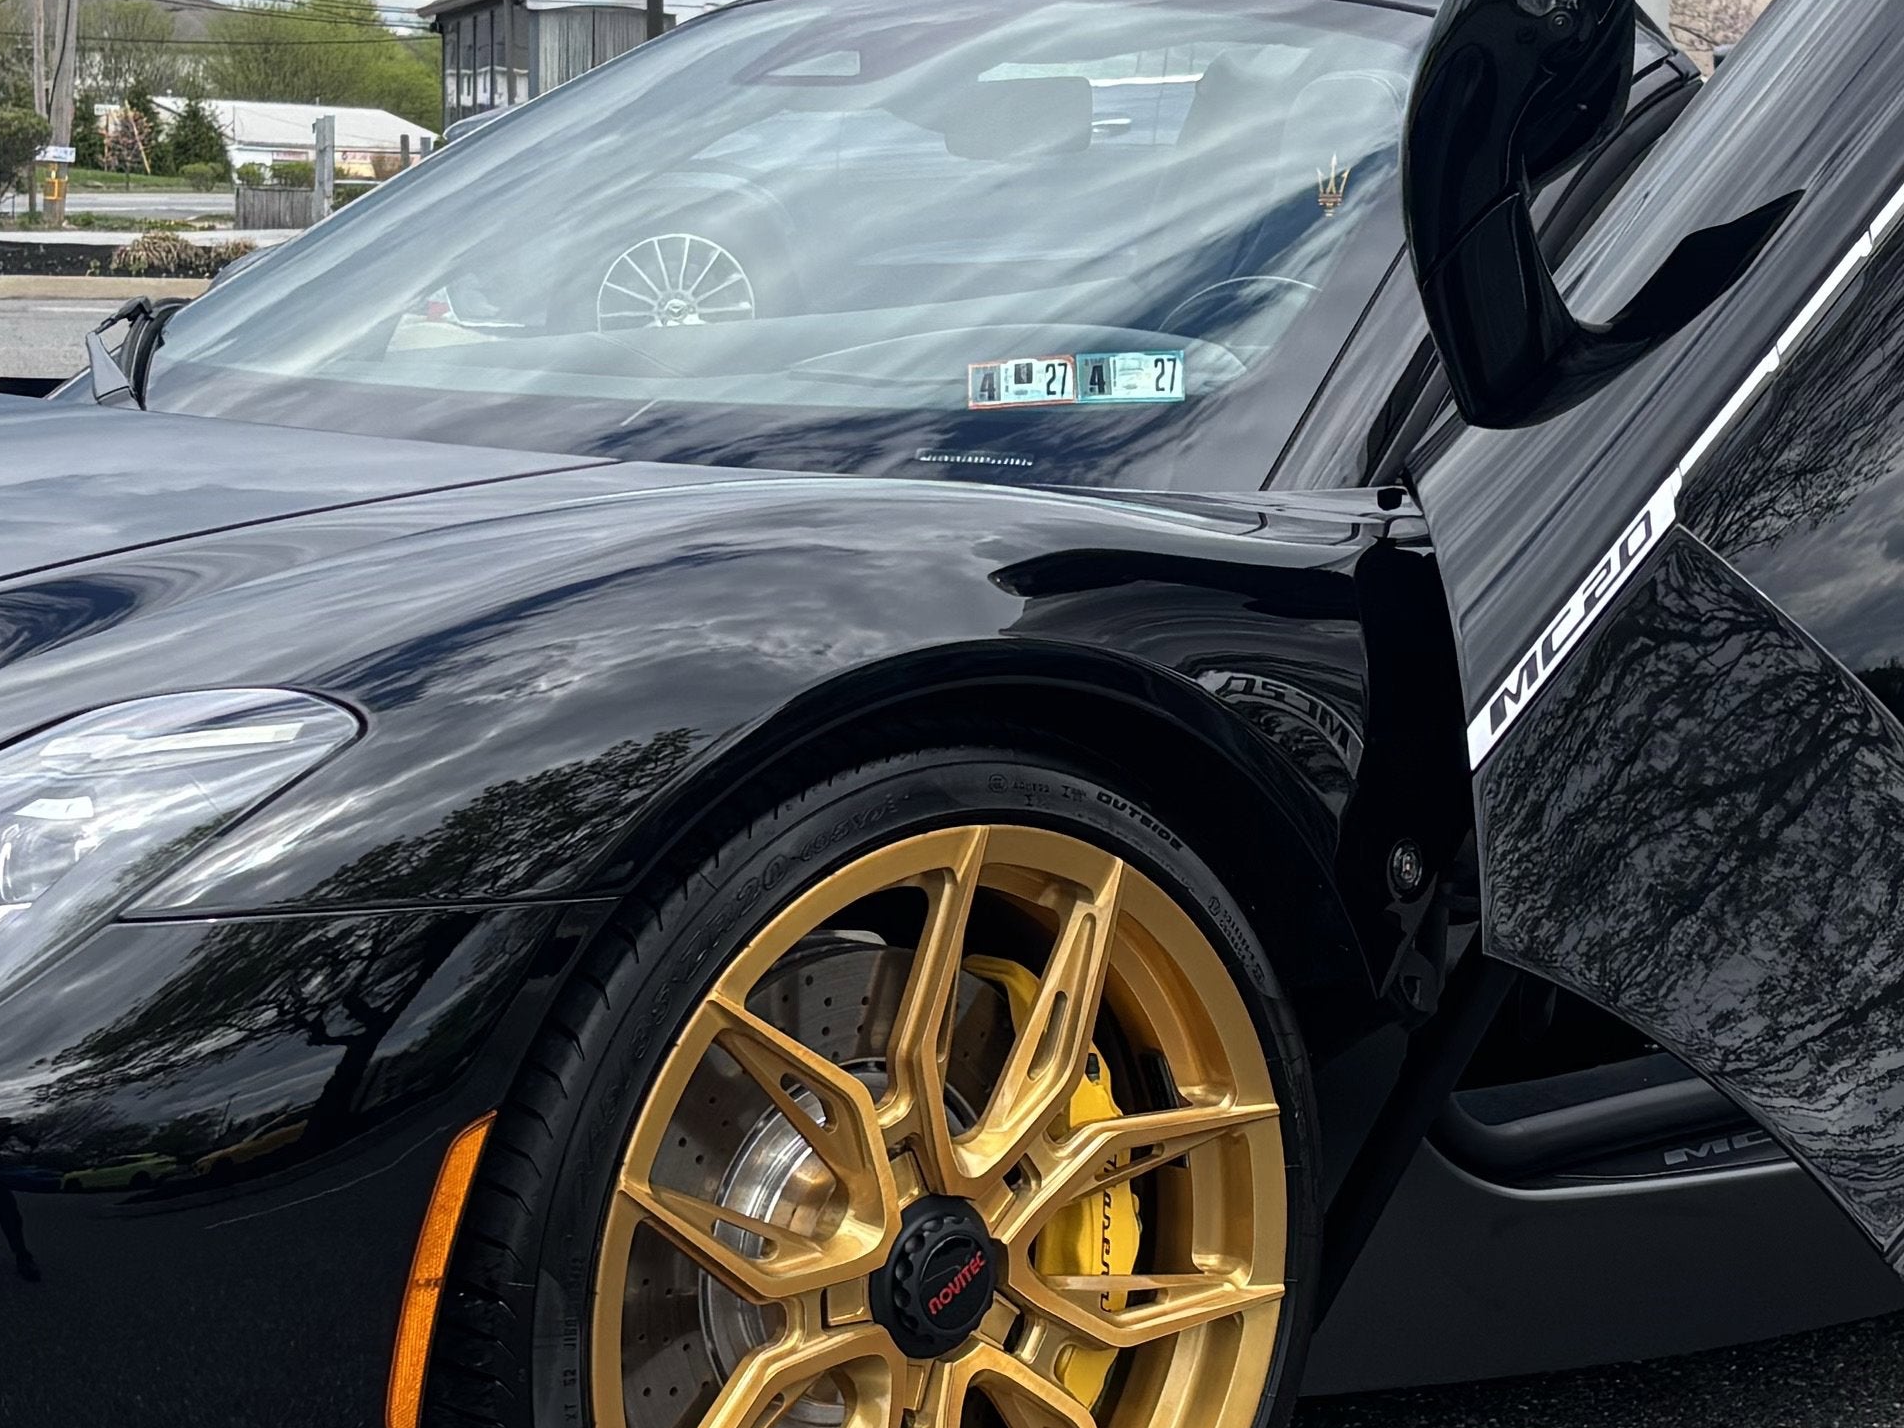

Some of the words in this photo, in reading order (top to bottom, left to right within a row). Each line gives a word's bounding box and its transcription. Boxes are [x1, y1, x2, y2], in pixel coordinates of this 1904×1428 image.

[979, 372, 996, 401] 4
[1045, 362, 1067, 397] 27
[1089, 365, 1106, 395] 4
[1154, 358, 1177, 394] 27
[1489, 509, 1653, 735] MC20
[1096, 791, 1184, 852] OUTSIDE
